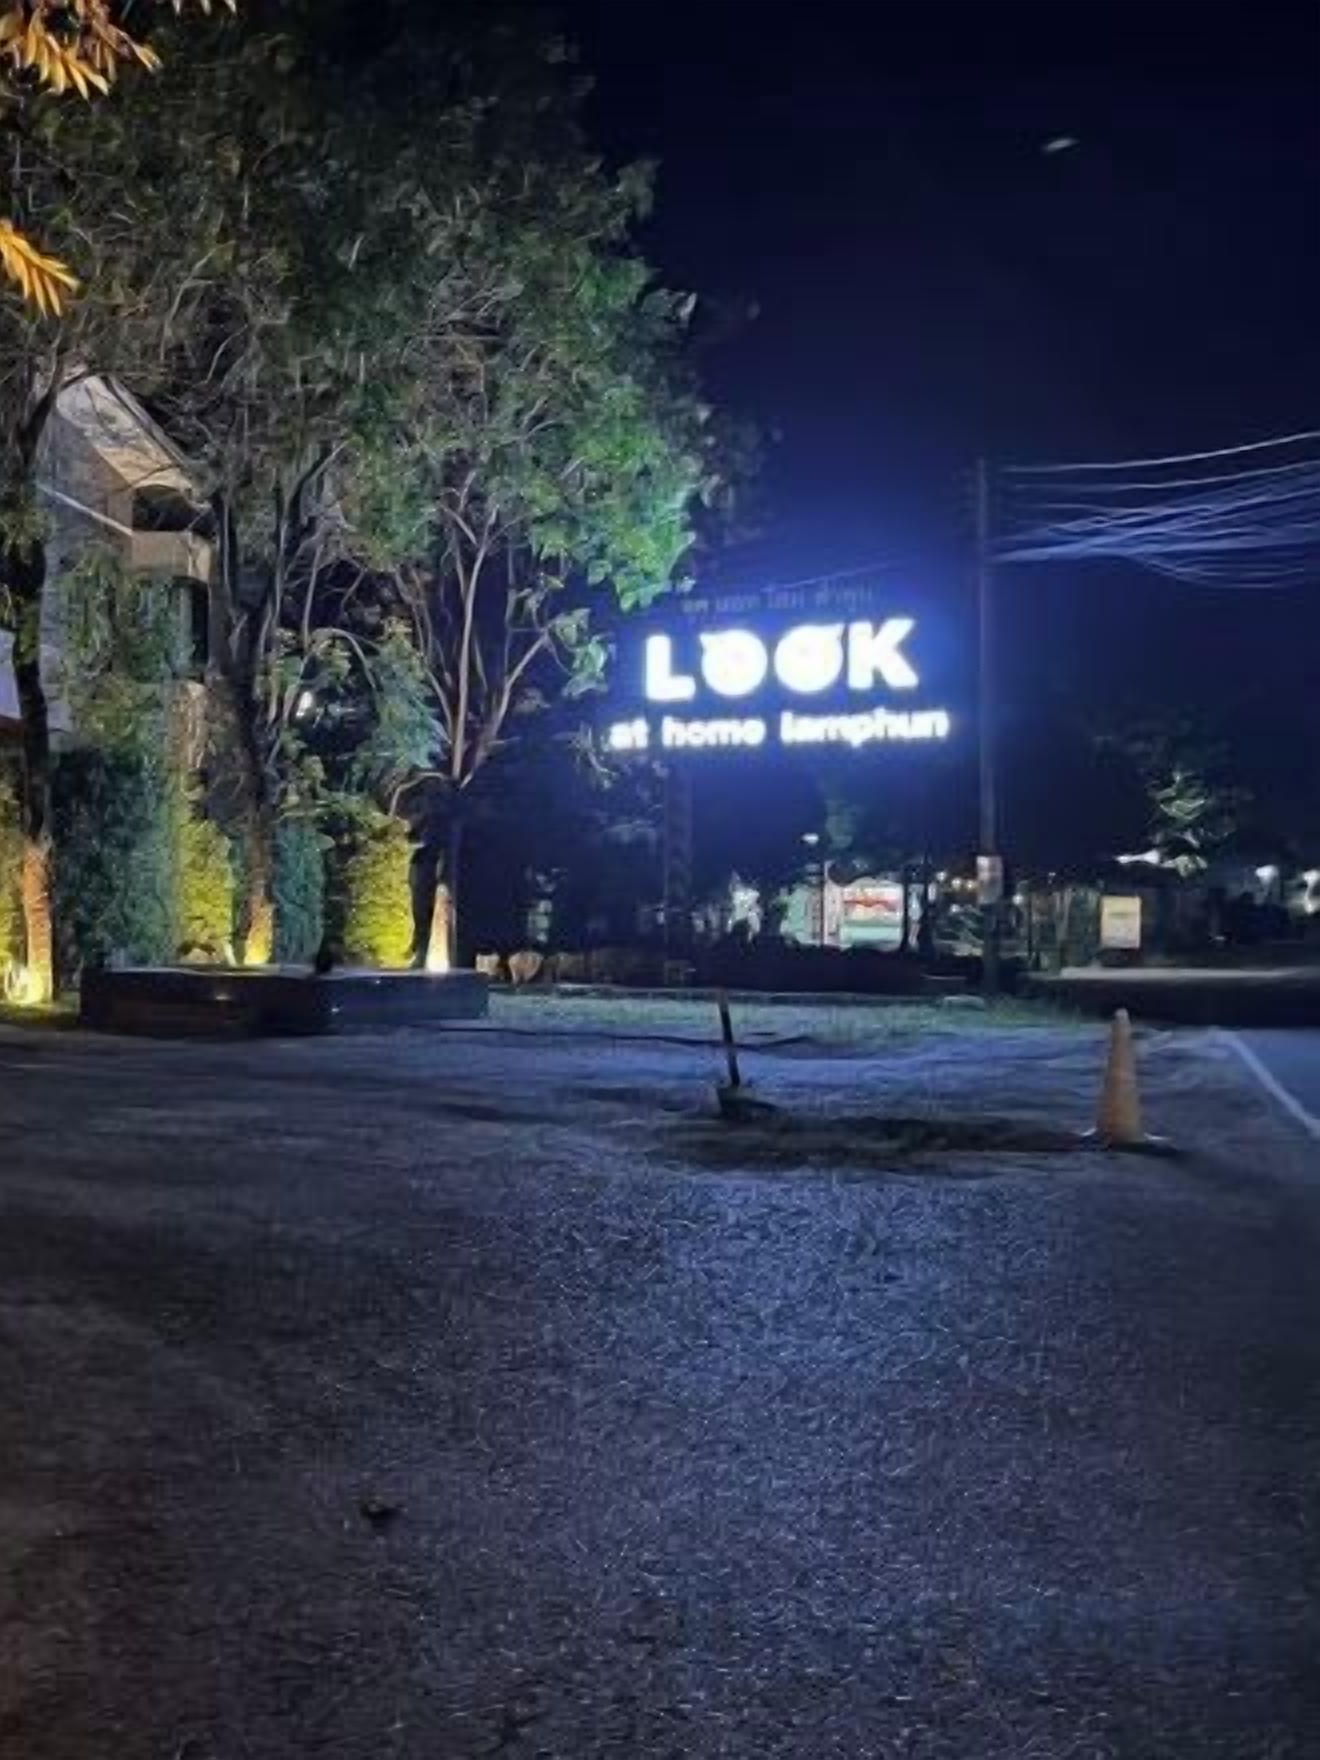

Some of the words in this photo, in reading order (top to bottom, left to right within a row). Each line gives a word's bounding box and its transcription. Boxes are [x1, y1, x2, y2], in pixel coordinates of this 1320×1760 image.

[645, 617, 920, 701] LOOK
[609, 717, 649, 750] at
[662, 716, 767, 747] home
